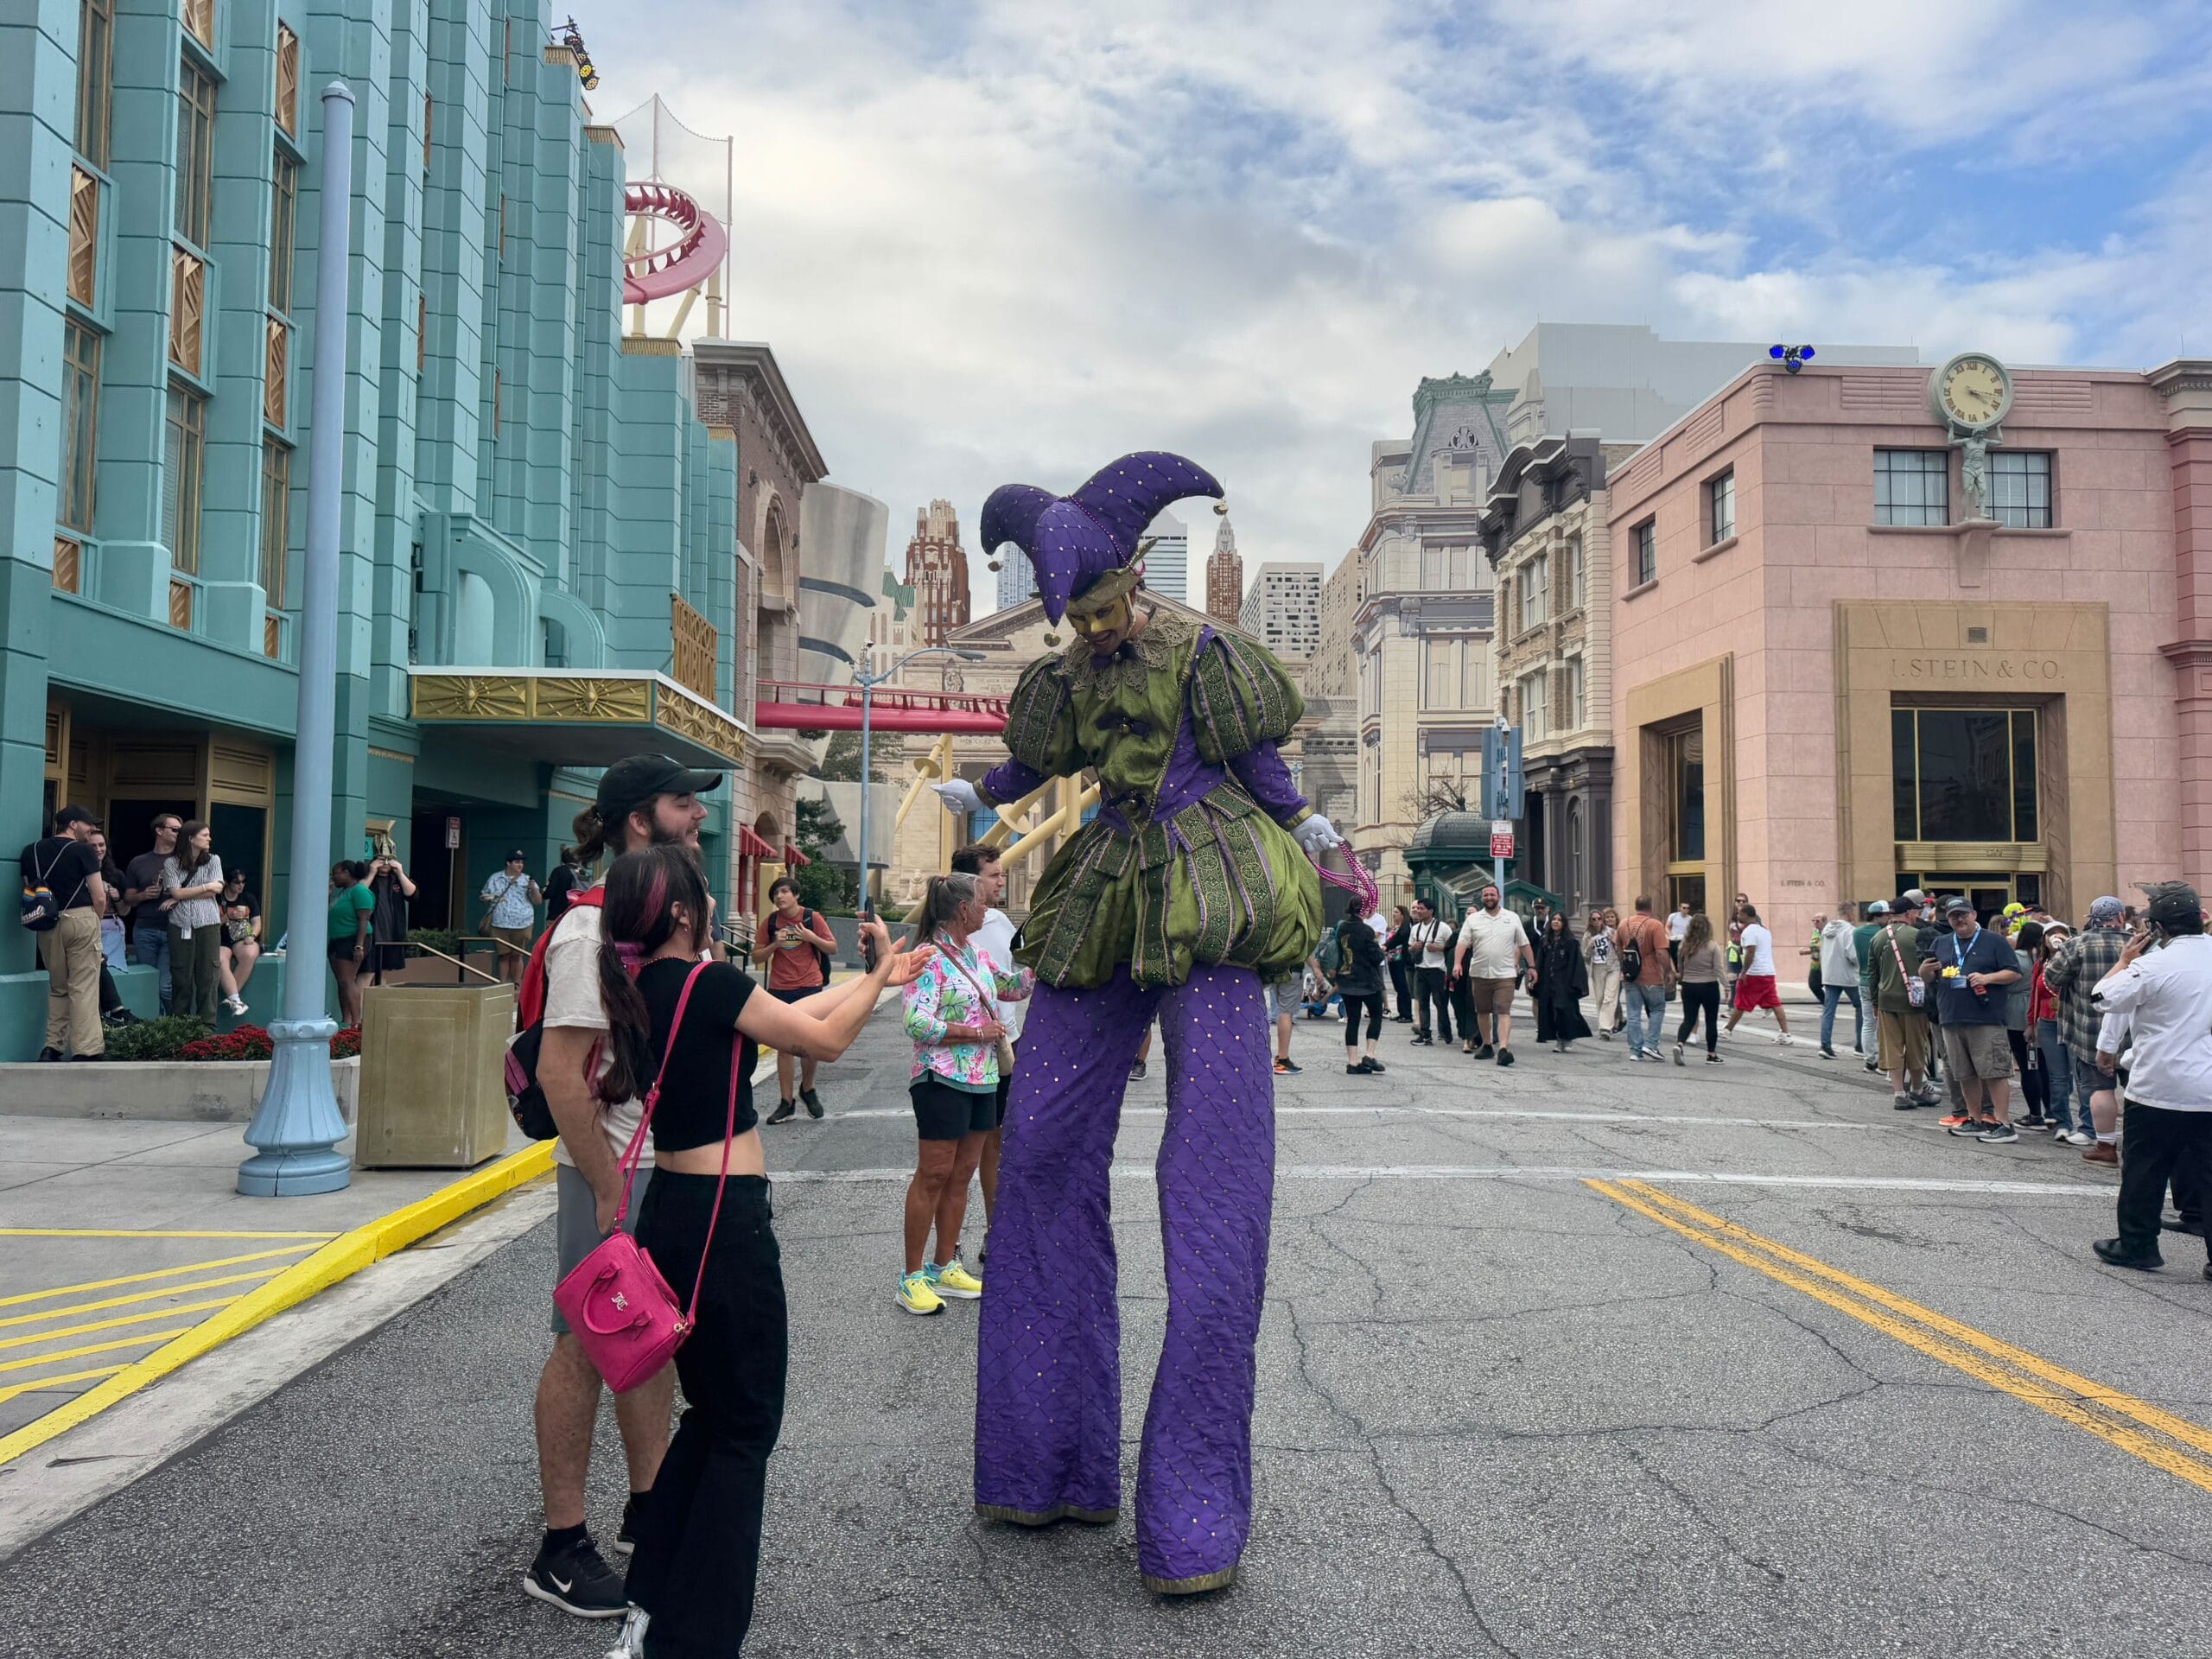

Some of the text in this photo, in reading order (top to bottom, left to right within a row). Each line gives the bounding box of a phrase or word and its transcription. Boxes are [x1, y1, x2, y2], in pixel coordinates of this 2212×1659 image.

[1910, 658, 1989, 678] STEIN
[1997, 659, 2014, 678] &
[2022, 659, 2066, 680] CO.
